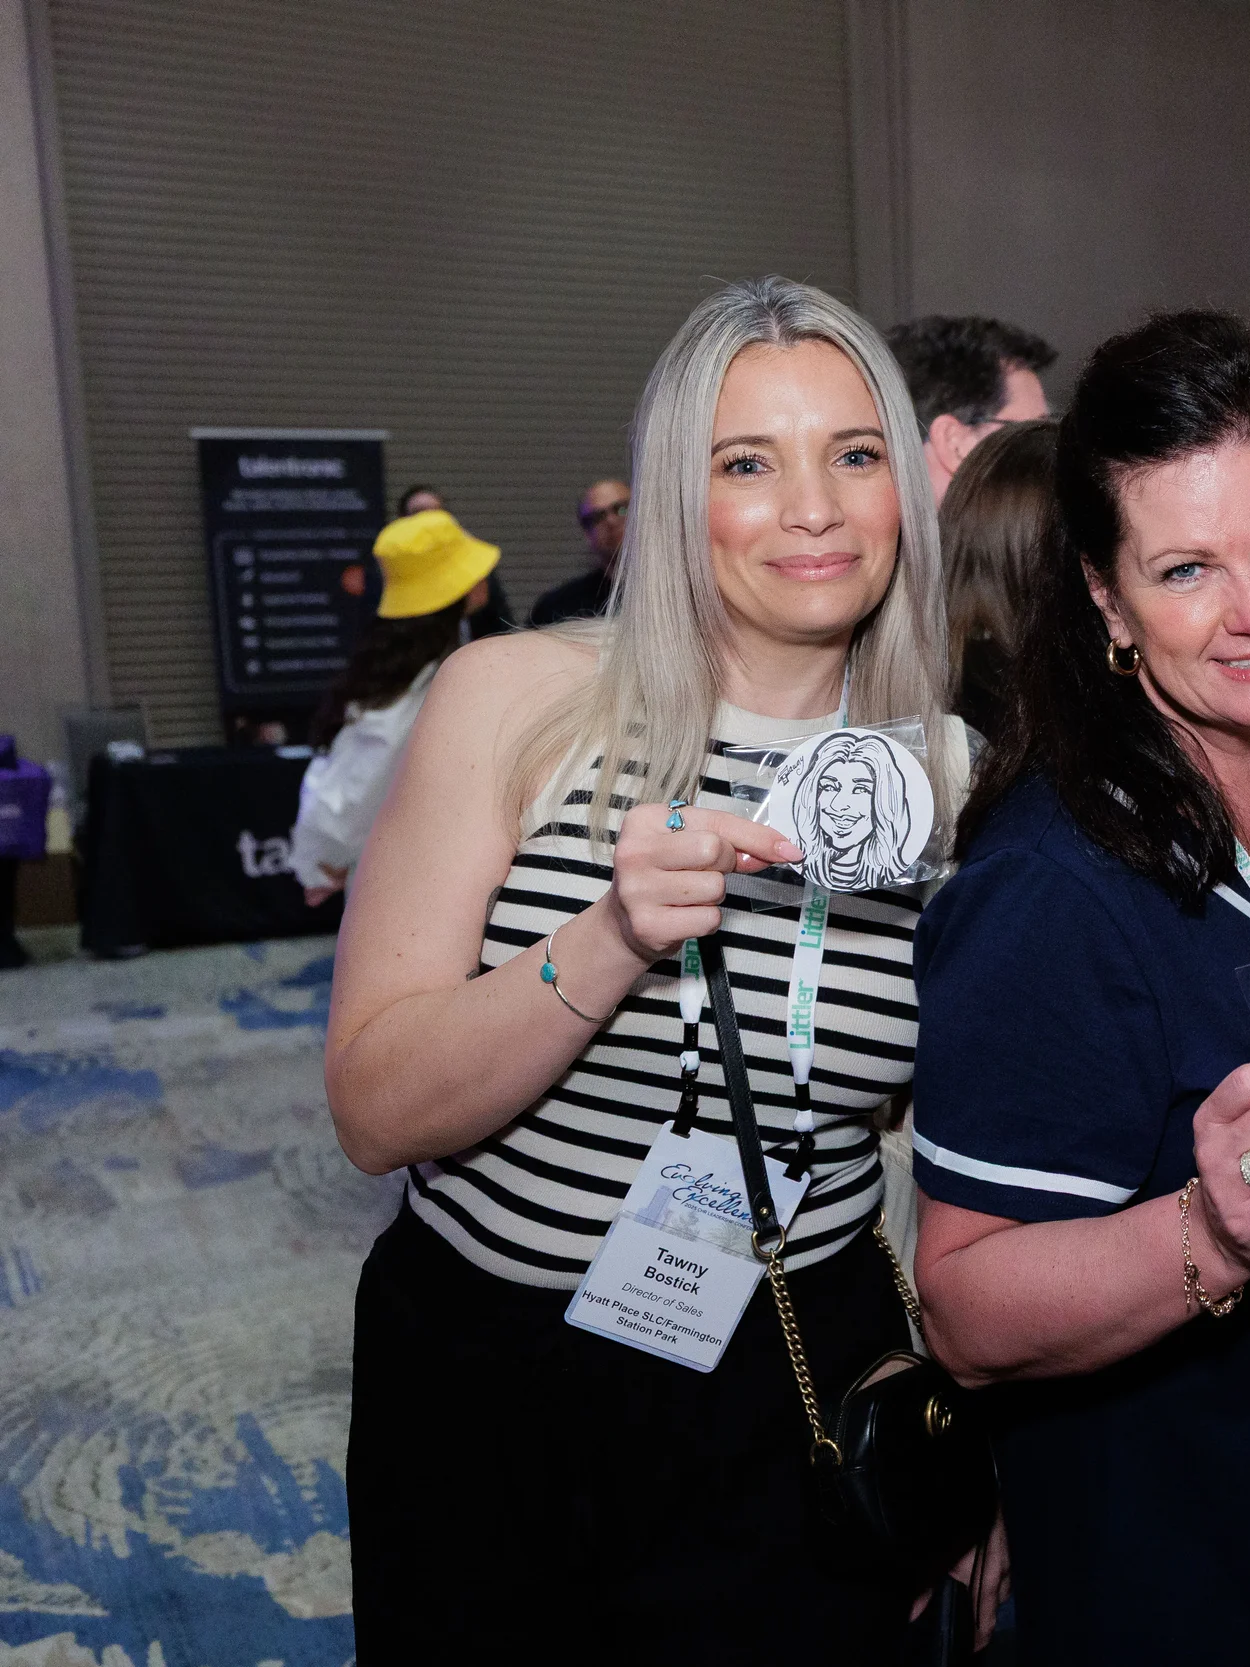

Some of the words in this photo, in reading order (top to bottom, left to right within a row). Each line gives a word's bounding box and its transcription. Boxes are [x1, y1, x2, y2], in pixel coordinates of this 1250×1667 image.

[799, 886, 828, 949] Littler
[789, 978, 814, 1050] Littler
[643, 1265, 701, 1295] Bostick
[656, 1246, 709, 1279] Tawny
[581, 1289, 610, 1307] Hyatt
[611, 1300, 640, 1317] Place
[641, 1311, 722, 1346] SLC/Farmington
[621, 1282, 662, 1303] Director
[662, 1298, 676, 1307] of
[675, 1301, 704, 1318] Sales
[616, 1316, 653, 1336] Station
[654, 1329, 678, 1344] Park
